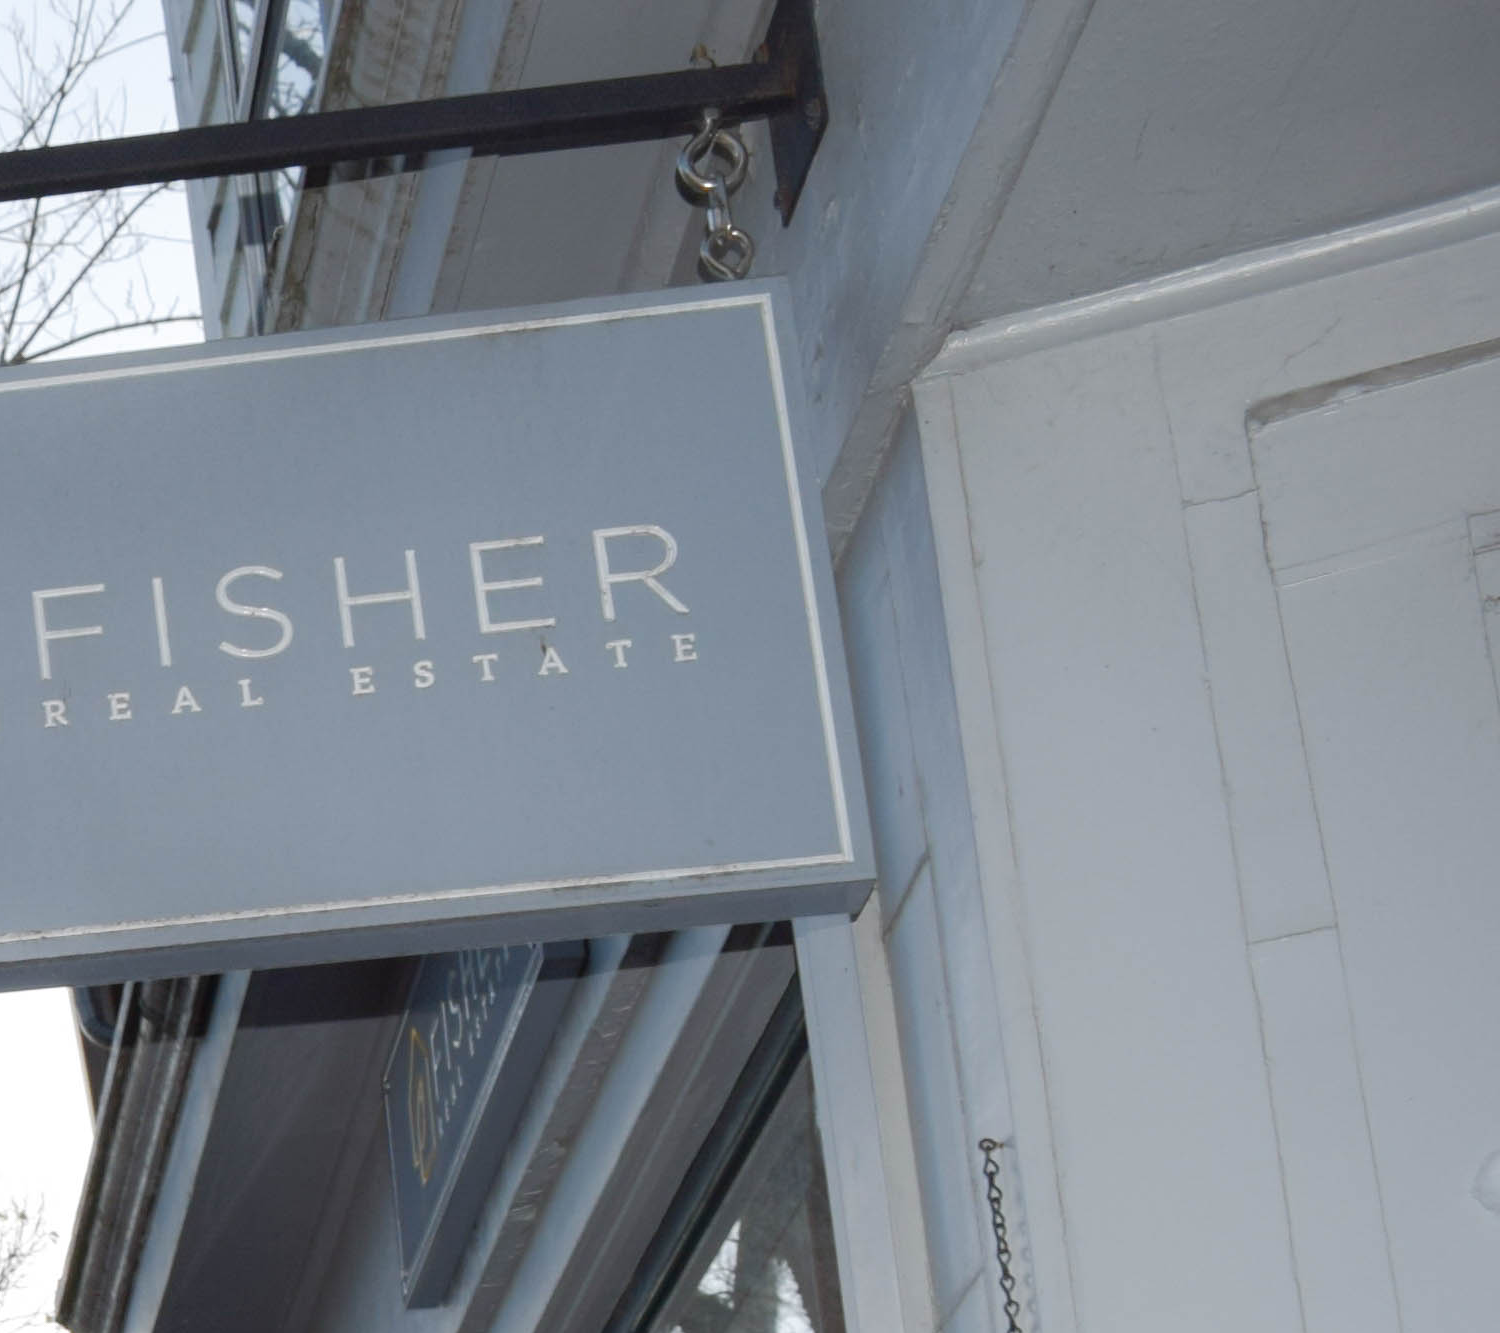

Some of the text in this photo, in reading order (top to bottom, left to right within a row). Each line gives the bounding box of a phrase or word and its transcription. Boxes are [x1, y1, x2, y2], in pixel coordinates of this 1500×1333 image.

[31, 523, 690, 680] FISHER
[42, 632, 699, 729] REAL ESTATE
